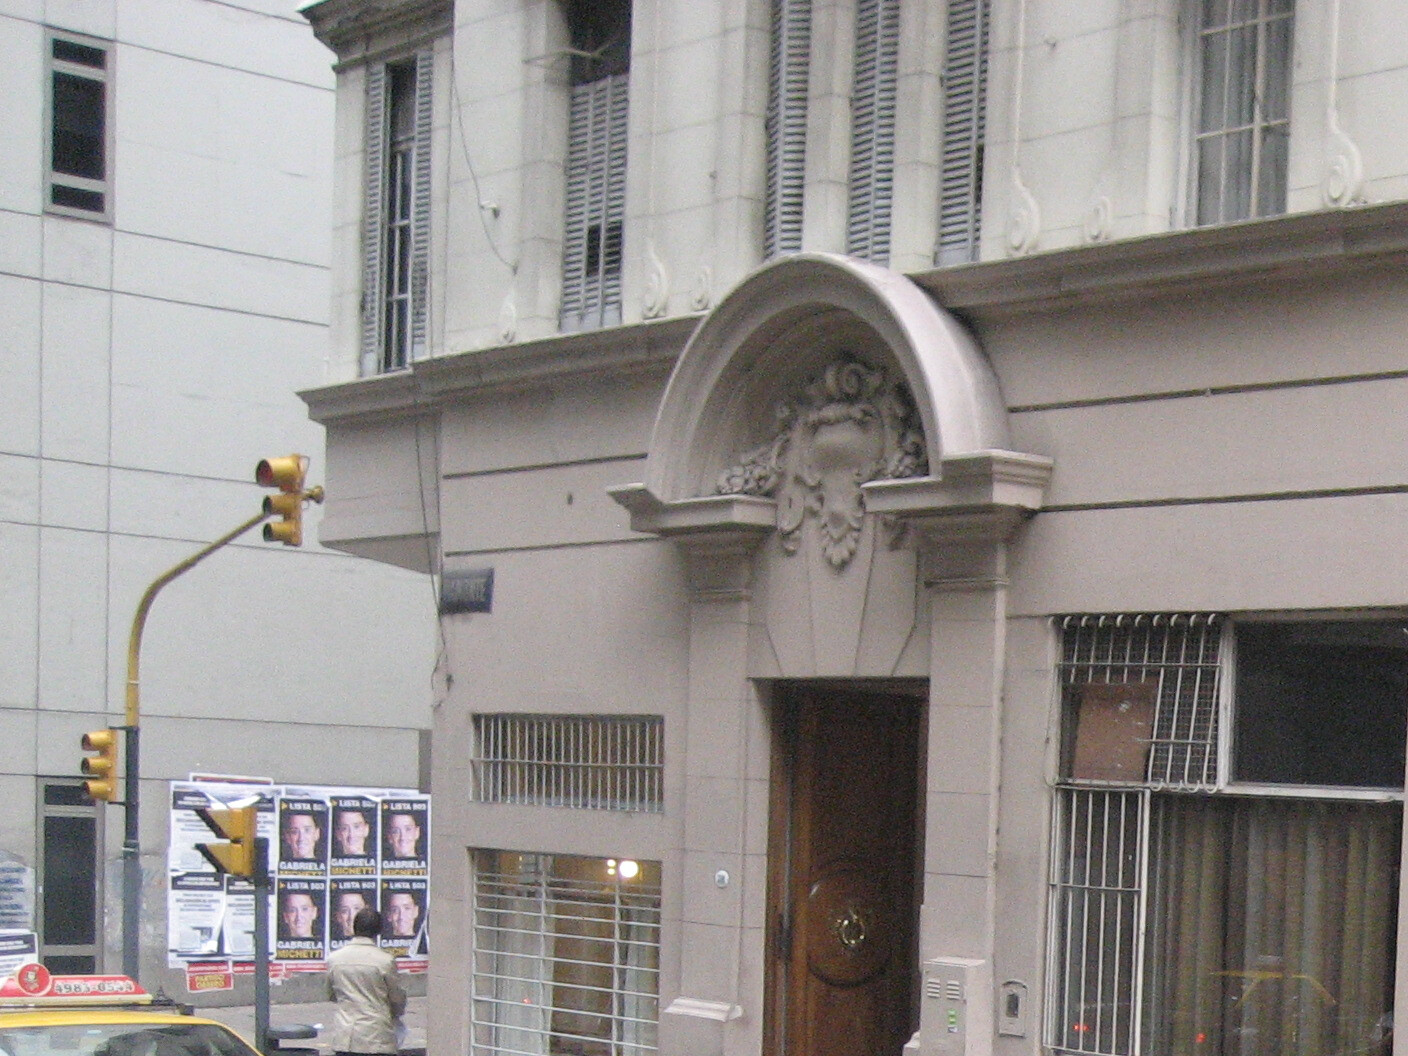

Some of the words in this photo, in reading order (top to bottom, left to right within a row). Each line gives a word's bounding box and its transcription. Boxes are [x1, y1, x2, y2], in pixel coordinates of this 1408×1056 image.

[390, 803, 411, 811] LISTA
[279, 861, 326, 870] GABRIELA
[331, 858, 376, 867] GABRIELA
[382, 860, 426, 869] GABRIELA
[287, 882, 309, 890] LISTA
[339, 881, 361, 889] LISTA
[389, 881, 411, 889] LISTA
[277, 940, 324, 949] GABRIELA
[277, 950, 323, 958] MICHETTI
